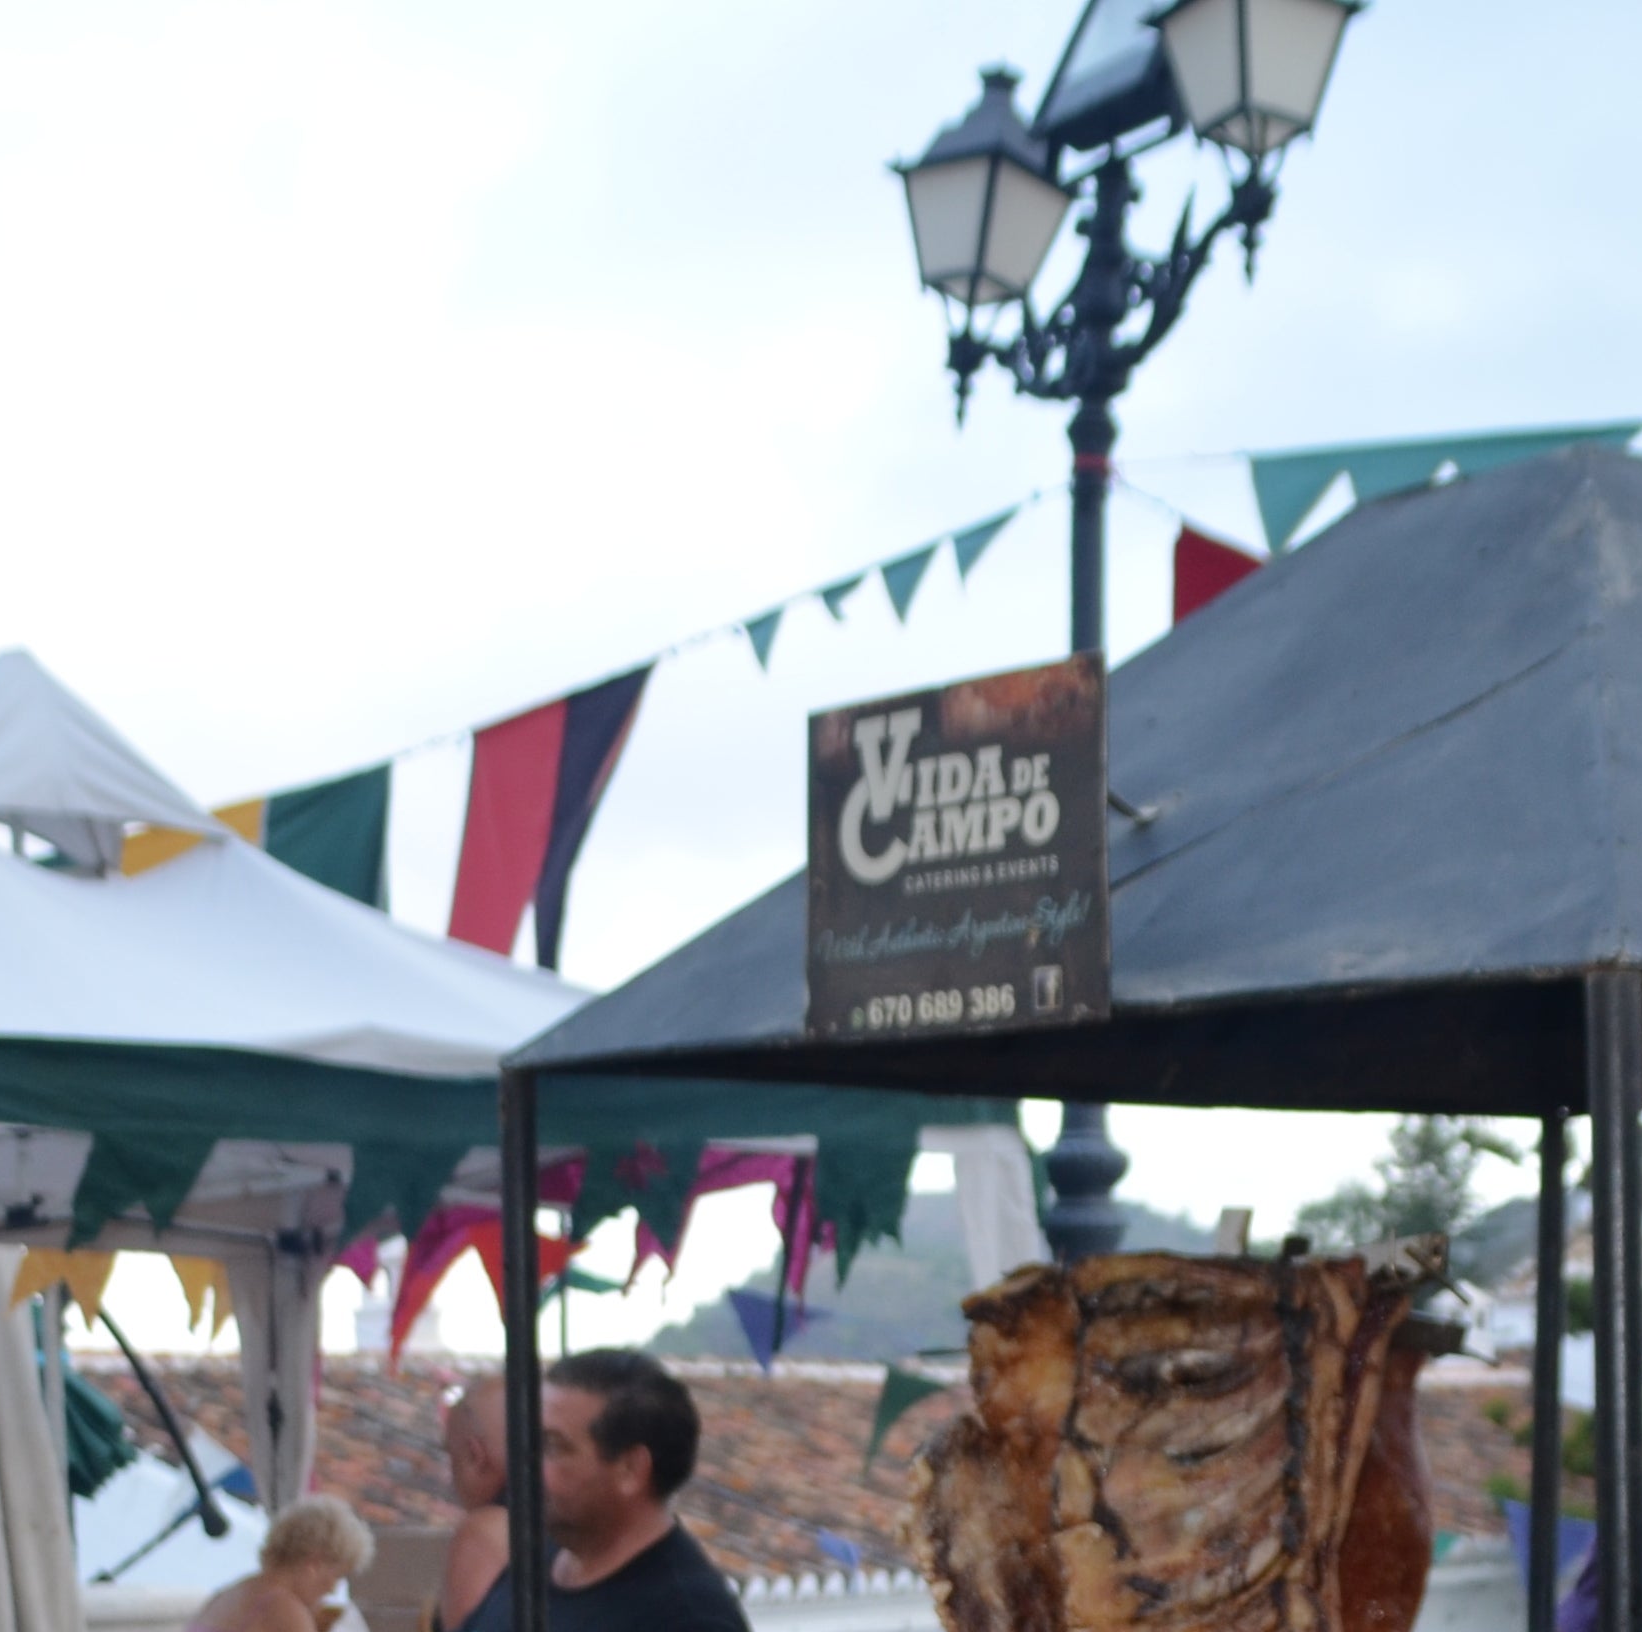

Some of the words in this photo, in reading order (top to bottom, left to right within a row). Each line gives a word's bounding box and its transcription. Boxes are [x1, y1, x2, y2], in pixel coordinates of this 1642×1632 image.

[854, 707, 1007, 825] VIDA
[1012, 753, 1051, 793] DE
[839, 763, 1060, 886] CAMPO
[904, 863, 980, 894] CATERING
[997, 854, 1060, 881] EVENTS
[866, 994, 913, 1029] 670
[919, 989, 963, 1025] 689
[969, 983, 1016, 1020] 386
